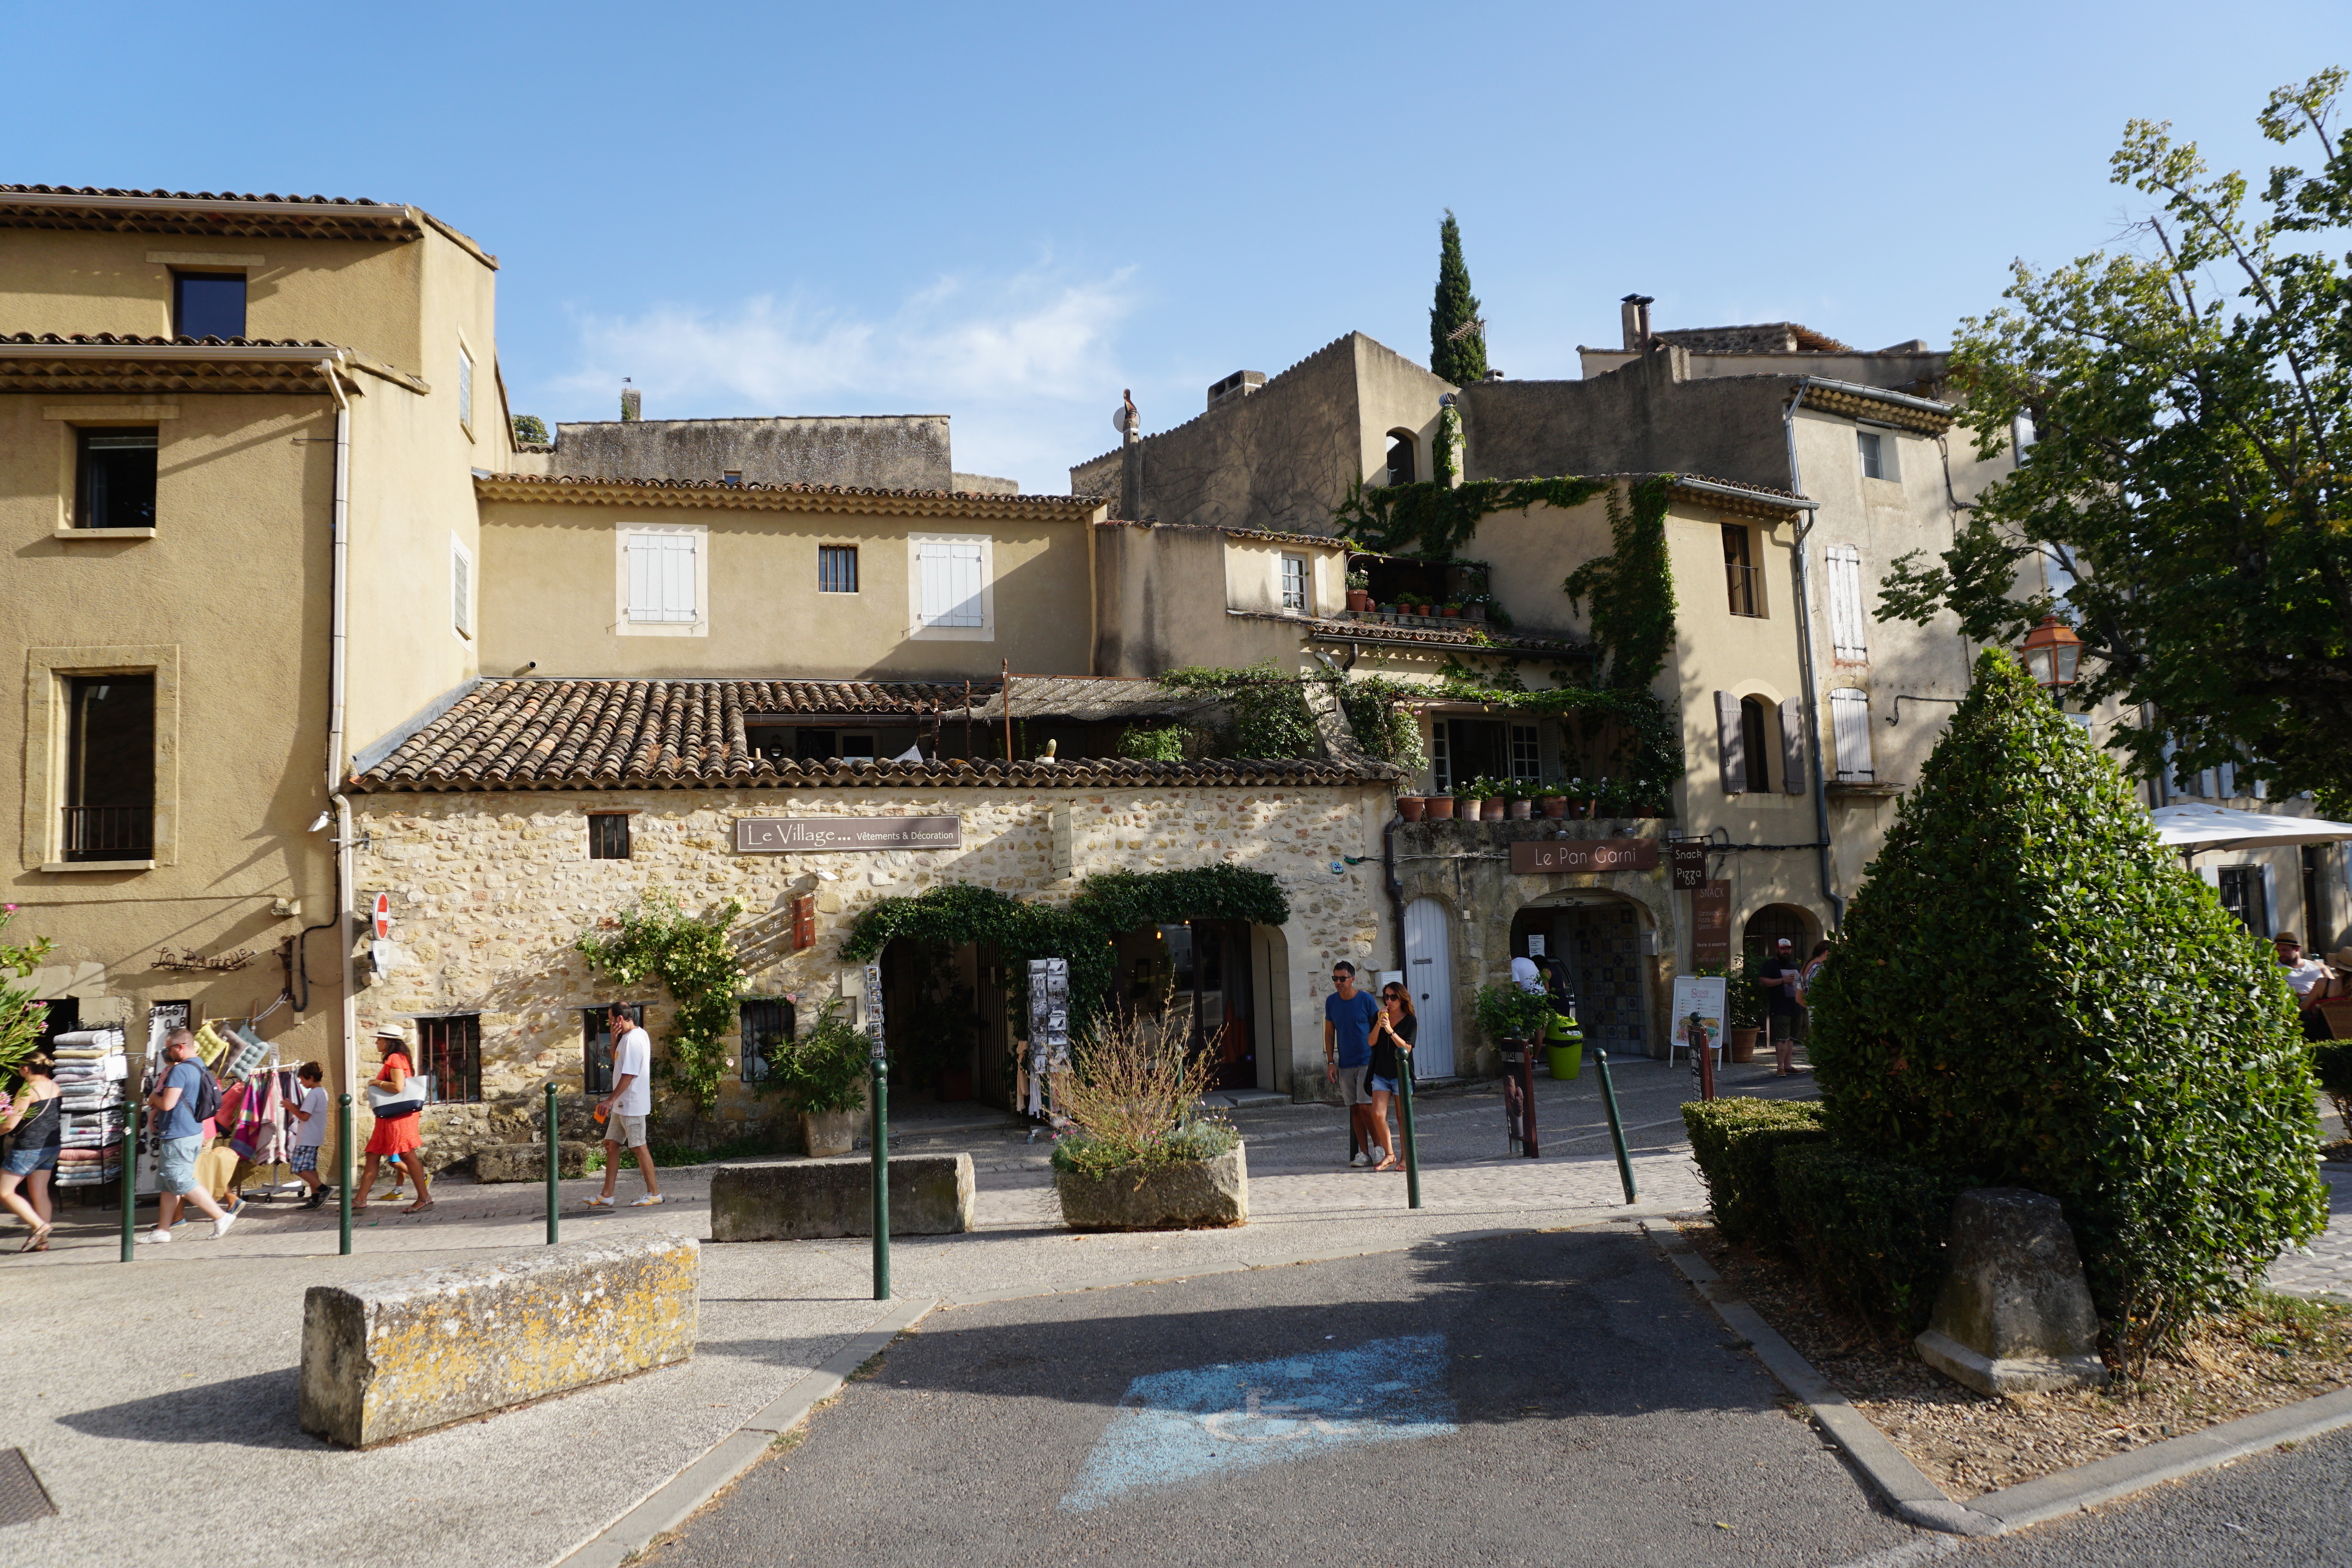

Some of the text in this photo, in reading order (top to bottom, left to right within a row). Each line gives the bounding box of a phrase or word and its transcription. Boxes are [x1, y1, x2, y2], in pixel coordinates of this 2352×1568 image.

[748, 824, 772, 845] Le
[856, 831, 900, 841] Vêtements
[903, 831, 908, 840] &
[911, 831, 954, 840] Décoration
[1535, 846, 1636, 865] Le Pan Garni
[1676, 848, 1702, 860] Snack
[1677, 868, 1701, 885] Pizza
[1700, 887, 1724, 898] SNACK
